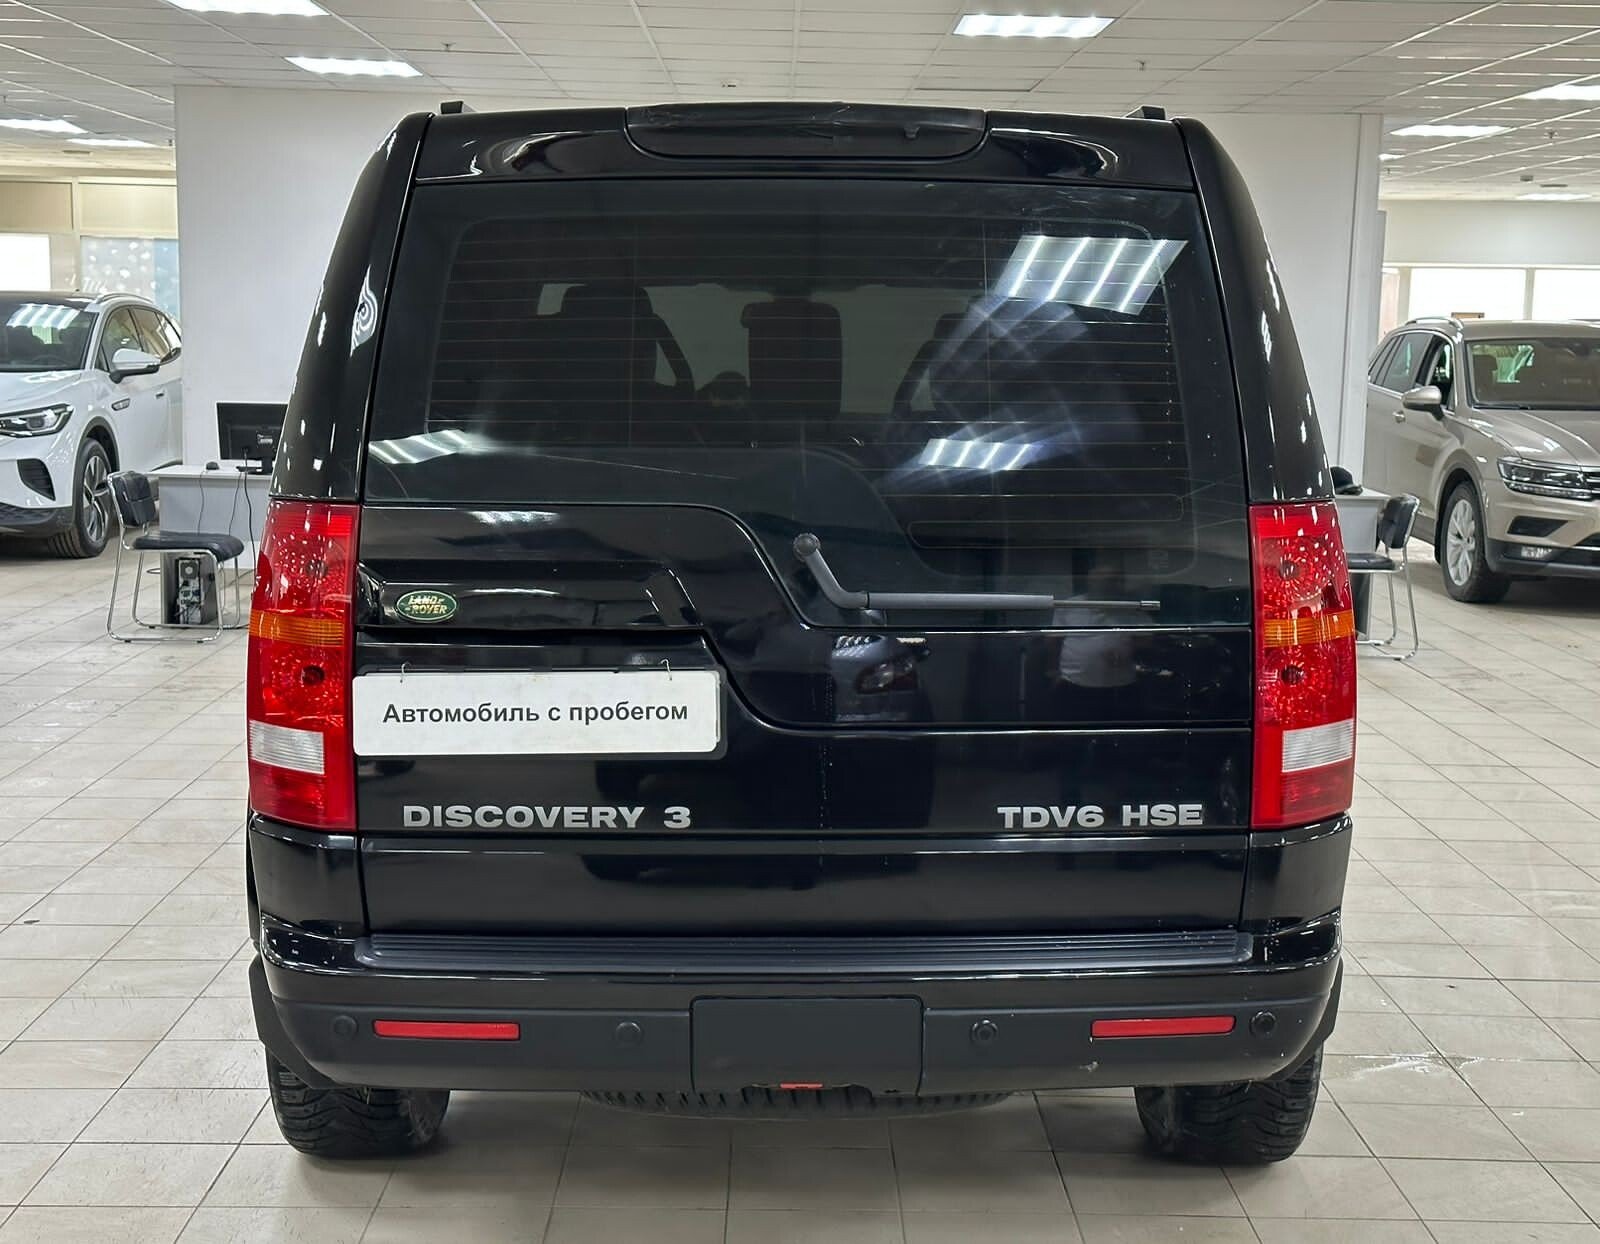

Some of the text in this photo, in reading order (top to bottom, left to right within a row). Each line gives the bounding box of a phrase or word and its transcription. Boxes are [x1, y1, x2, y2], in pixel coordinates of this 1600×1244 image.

[408, 595, 438, 605] LAND
[411, 604, 448, 614] ROVER
[383, 701, 688, 725] Автомобиль с пробегом
[403, 805, 692, 829] DISCOVERY 3
[997, 803, 1203, 829] TDV6 HSE
